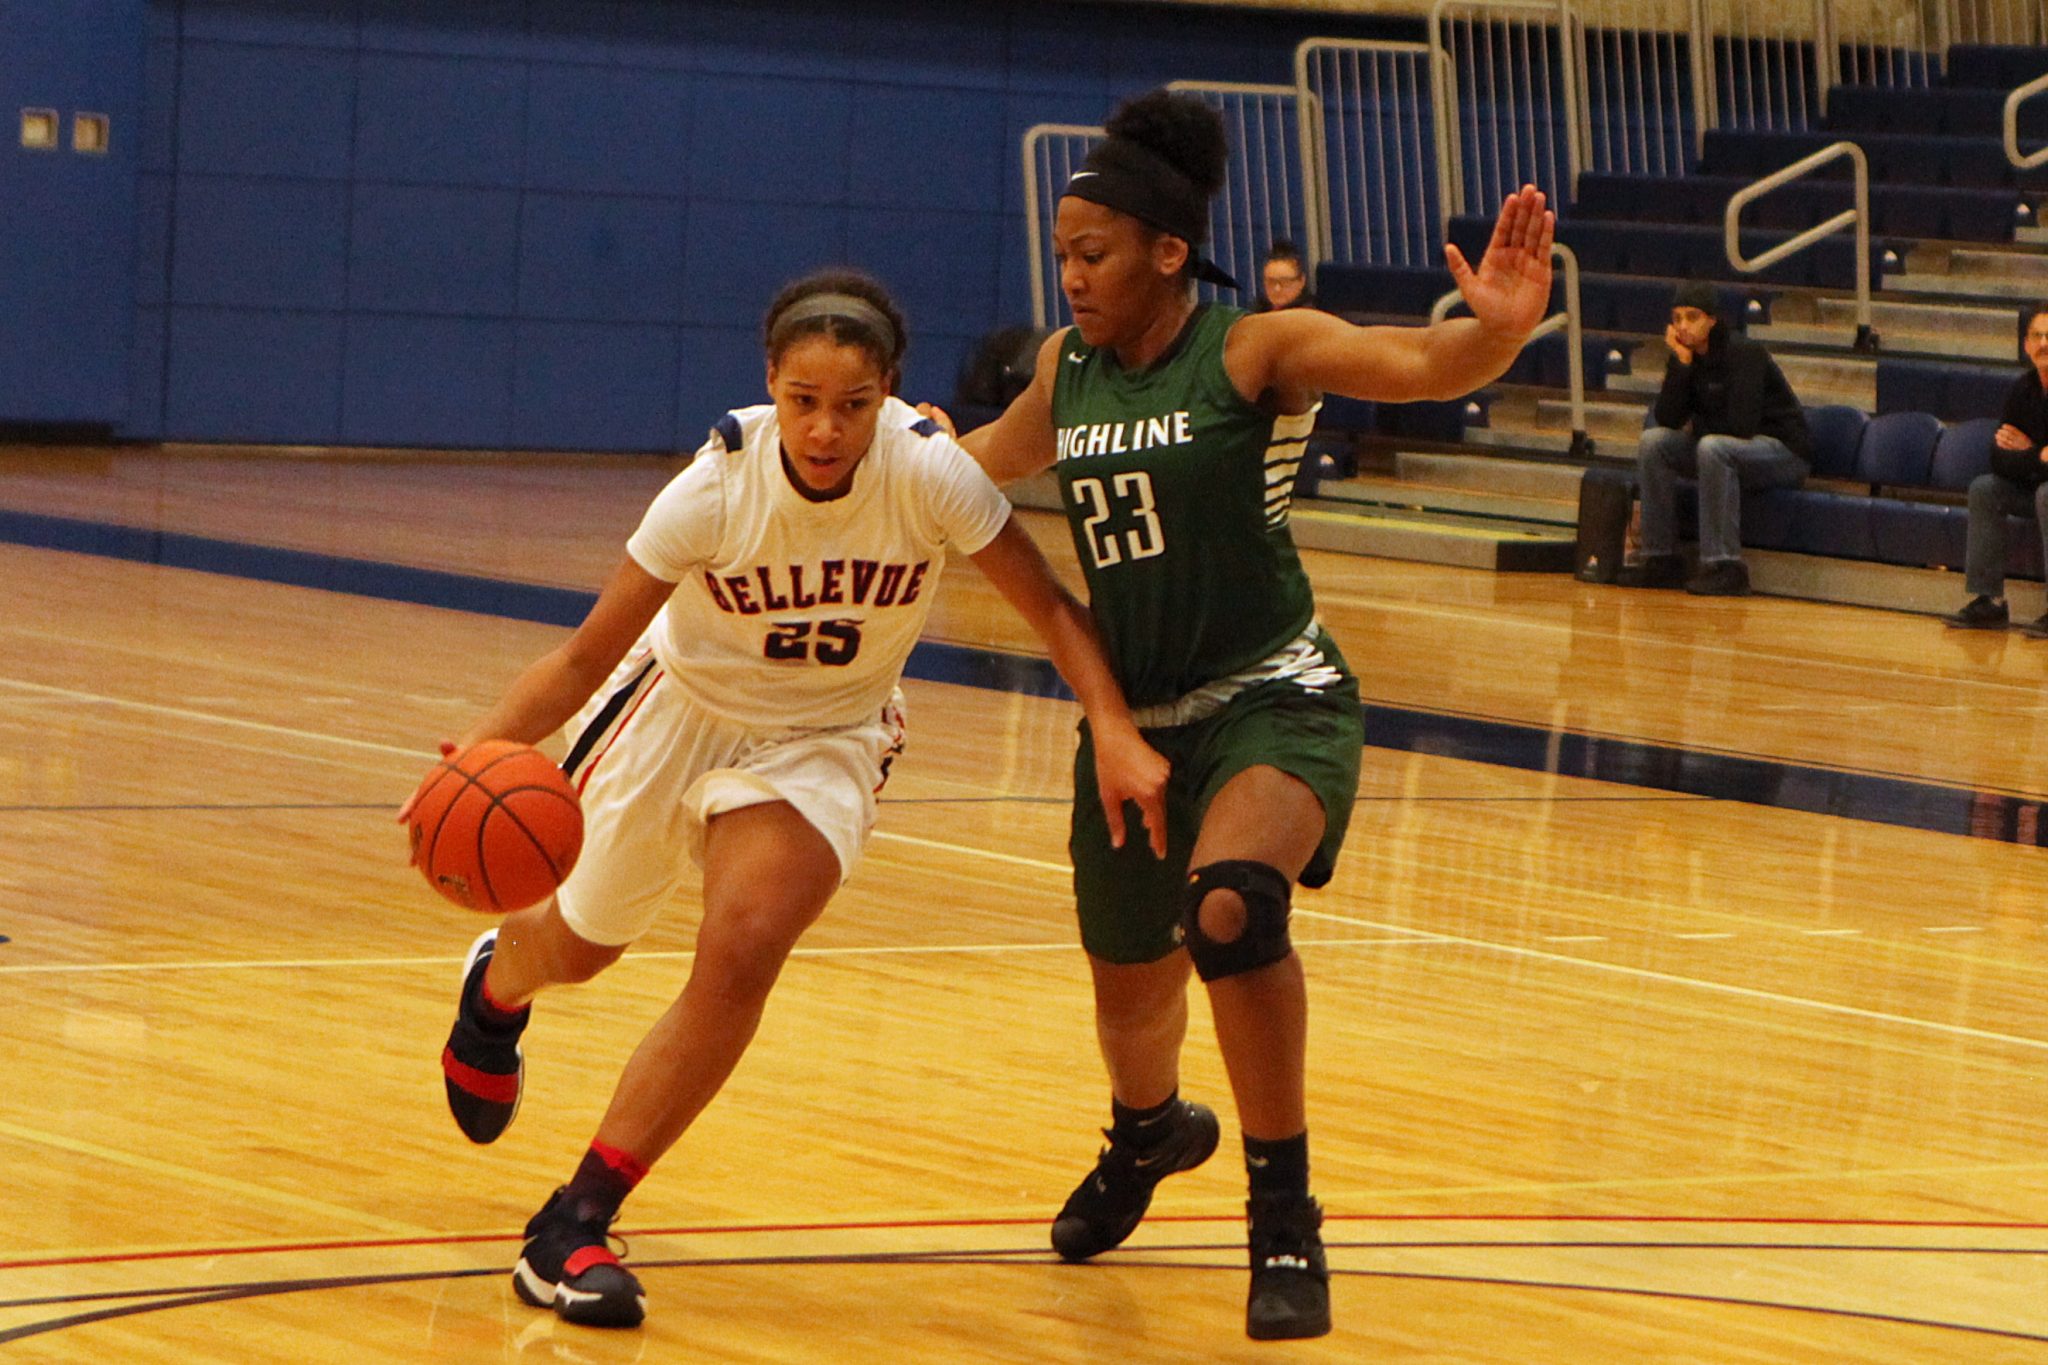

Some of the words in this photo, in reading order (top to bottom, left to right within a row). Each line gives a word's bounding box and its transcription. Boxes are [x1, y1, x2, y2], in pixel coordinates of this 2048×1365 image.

[1072, 471, 1165, 569] 23
[704, 559, 930, 615] BELLEVUE
[764, 618, 865, 666] 25
